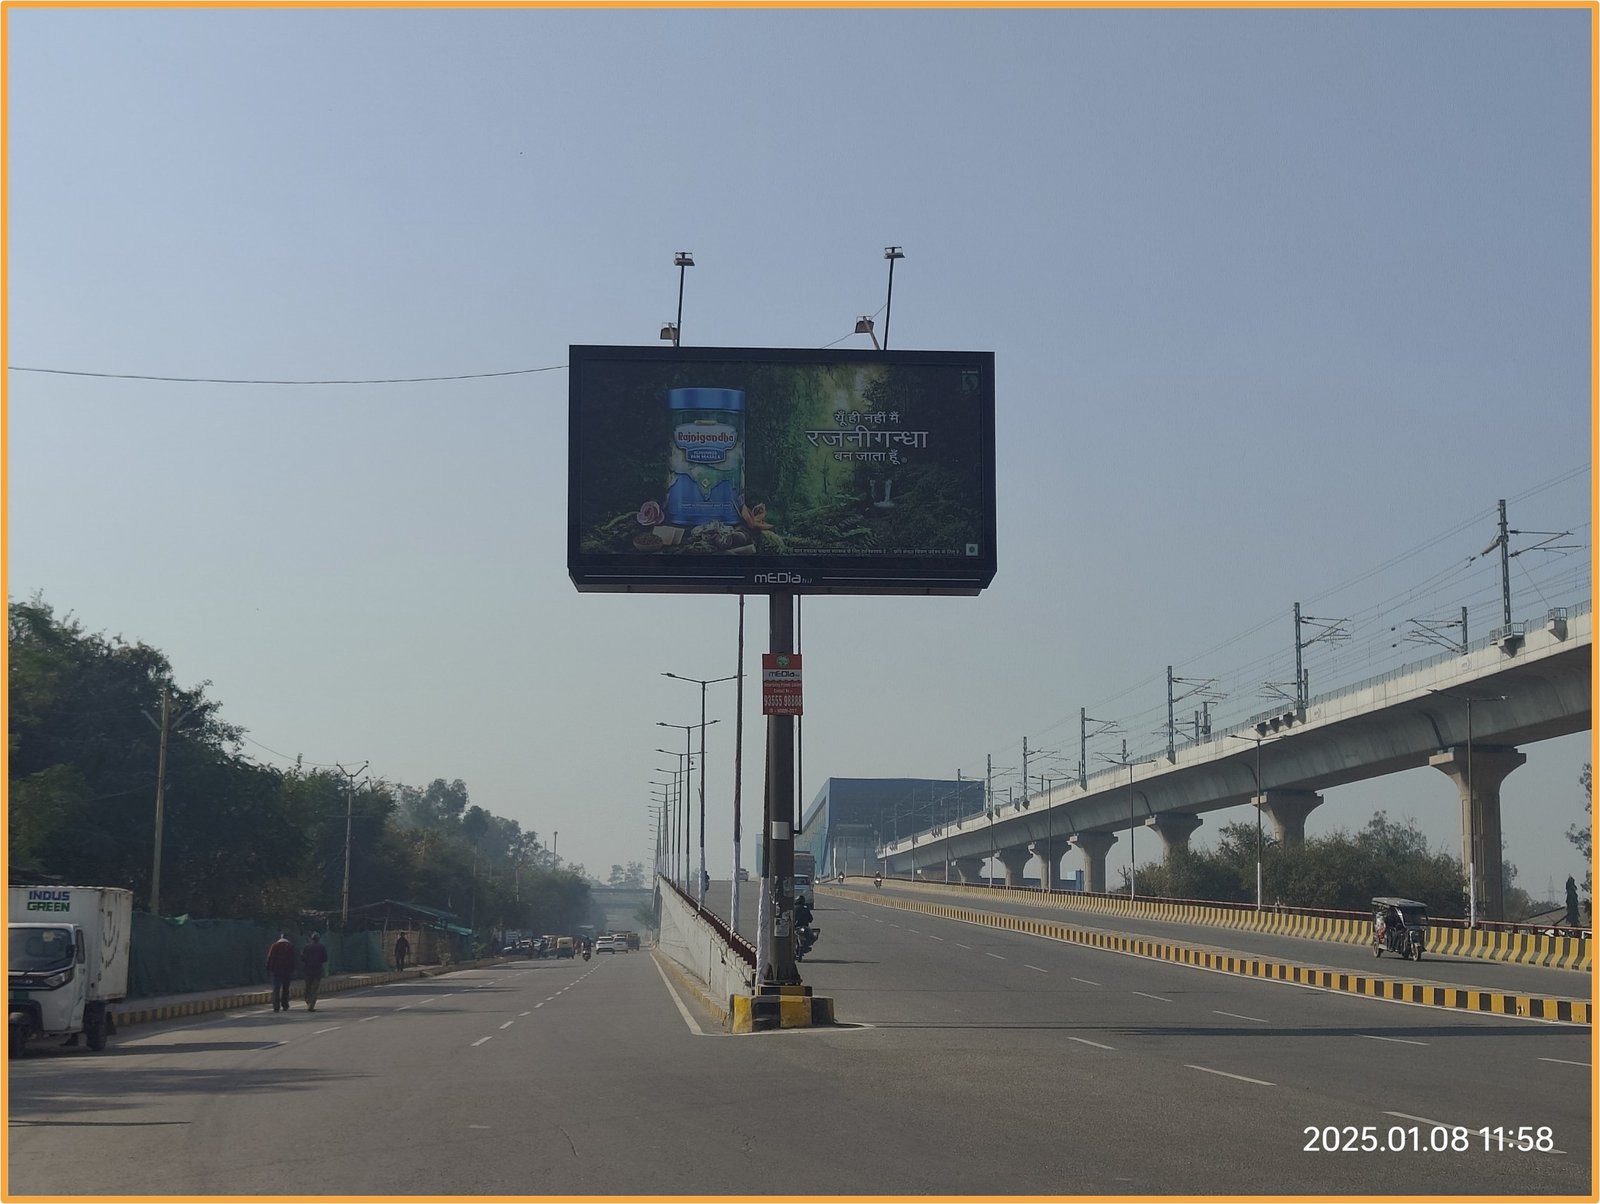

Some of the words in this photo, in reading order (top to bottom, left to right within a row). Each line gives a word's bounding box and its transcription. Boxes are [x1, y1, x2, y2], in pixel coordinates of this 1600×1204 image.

[848, 411, 861, 423] ही
[863, 411, 887, 423] नहीं
[678, 431, 734, 443] Rajnigandha
[804, 425, 929, 448] रजनीगन्धा
[833, 451, 852, 461] बन
[855, 451, 886, 461] जाता
[29, 890, 70, 901] INDUS
[27, 901, 70, 912] GREEN
